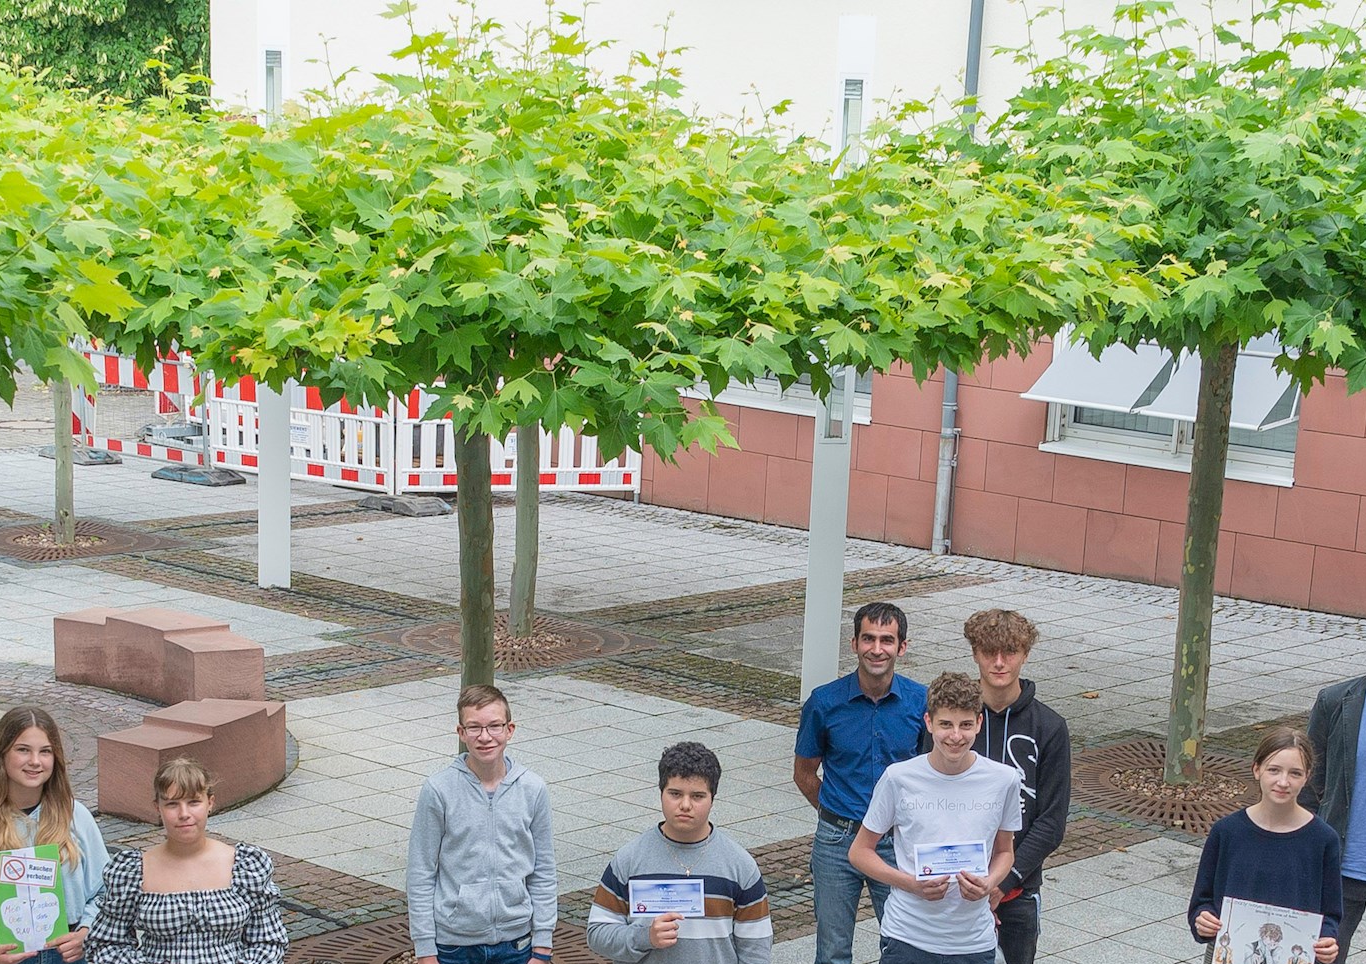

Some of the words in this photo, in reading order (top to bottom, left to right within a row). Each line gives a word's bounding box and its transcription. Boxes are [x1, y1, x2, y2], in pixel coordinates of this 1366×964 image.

[899, 798, 935, 811] Calvin
[937, 798, 966, 811] Klein
[967, 799, 1004, 811] Jeans
[28, 864, 53, 873] Rauchen
